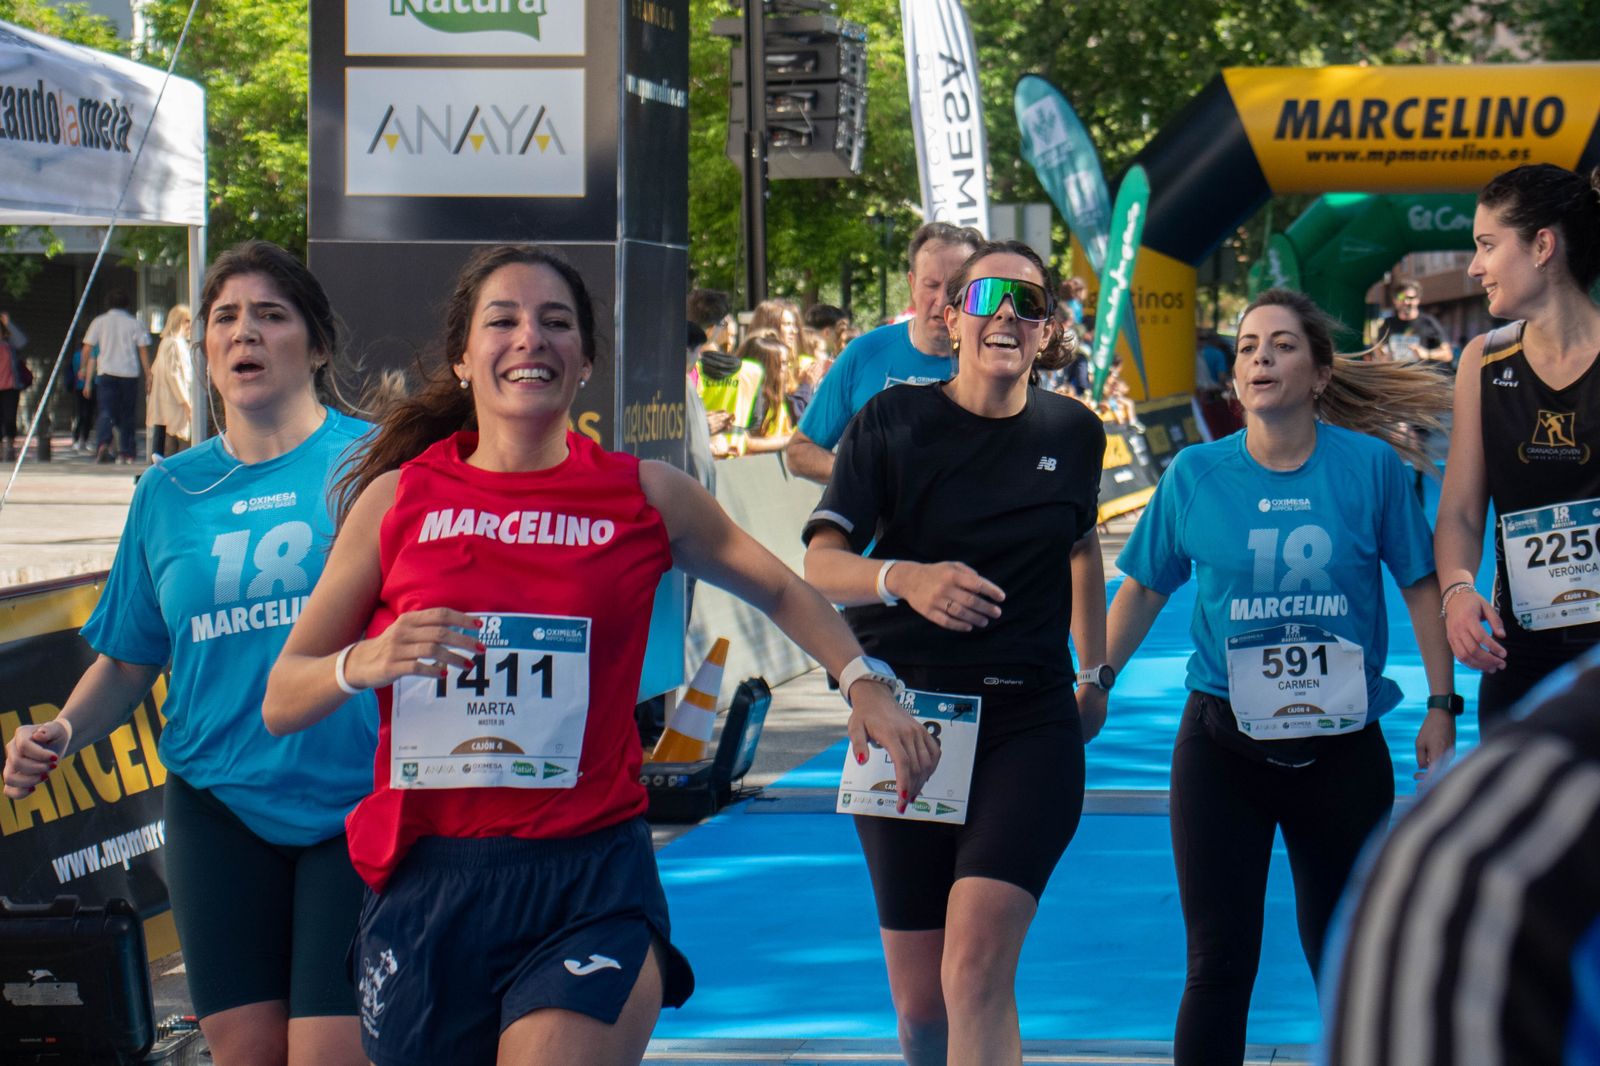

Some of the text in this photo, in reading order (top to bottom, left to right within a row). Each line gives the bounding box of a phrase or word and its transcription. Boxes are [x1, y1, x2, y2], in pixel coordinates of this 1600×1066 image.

[0, 79, 132, 153] andolameta
[1274, 97, 1566, 140] MARCELINO
[367, 104, 566, 155] ANAYA
[1306, 145, 1531, 165] www.mpmarcelino.es
[624, 390, 683, 456] agustinos
[1036, 456, 1057, 471] NB
[249, 491, 296, 506] OXIMESA
[1552, 506, 1569, 520] 18
[418, 508, 615, 546] MARCELINO
[210, 521, 313, 606] 18
[1247, 524, 1332, 593] 18
[1548, 562, 1600, 578] VERÓNICA
[1230, 594, 1348, 621] MARCELINO
[479, 616, 502, 634] 18
[546, 628, 582, 637] OXIMESA
[1284, 625, 1300, 635] 18
[1262, 645, 1328, 679] 591
[1278, 679, 1320, 691] CARMEN
[898, 691, 916, 705] 18
[467, 702, 515, 715] MARTA
[471, 740, 503, 751] CAJÓN 4
